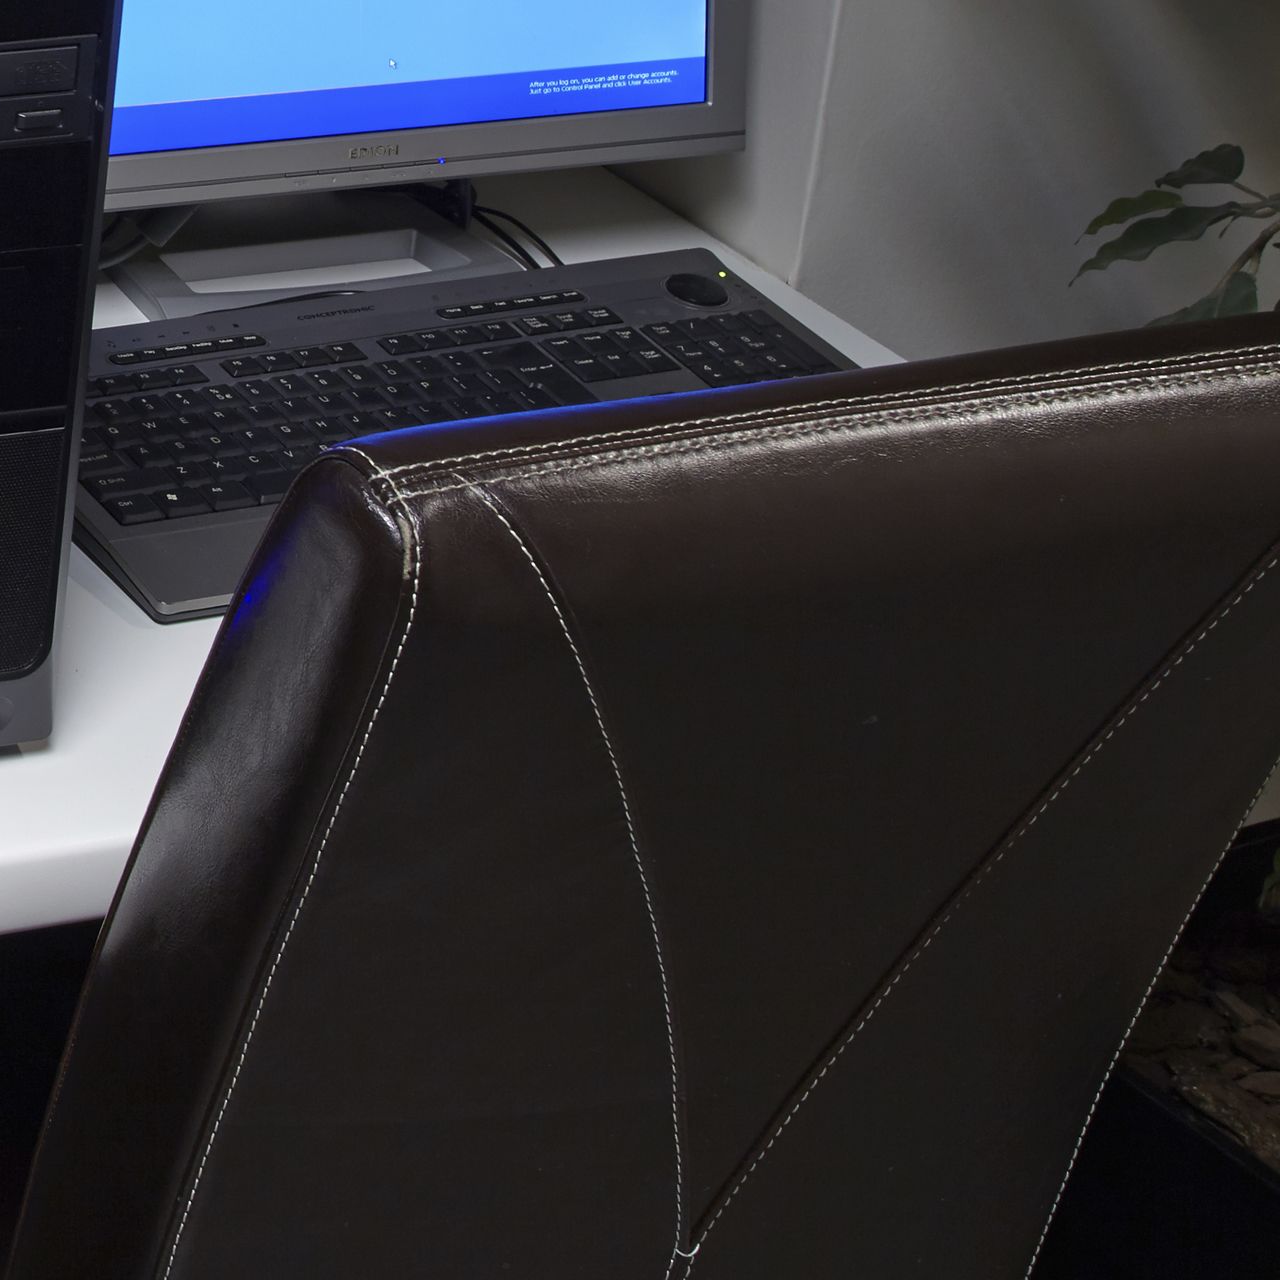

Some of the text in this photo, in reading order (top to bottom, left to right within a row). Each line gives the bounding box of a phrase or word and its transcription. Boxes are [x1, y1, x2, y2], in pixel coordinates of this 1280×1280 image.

[529, 87, 542, 95] Just
[561, 84, 583, 92] Control
[584, 82, 601, 90] Panel
[643, 77, 673, 85] Accounts.
[530, 80, 545, 88] After
[627, 71, 650, 80] change
[650, 70, 679, 78] accounts.
[297, 305, 376, 321] CONCEPTRONIC
